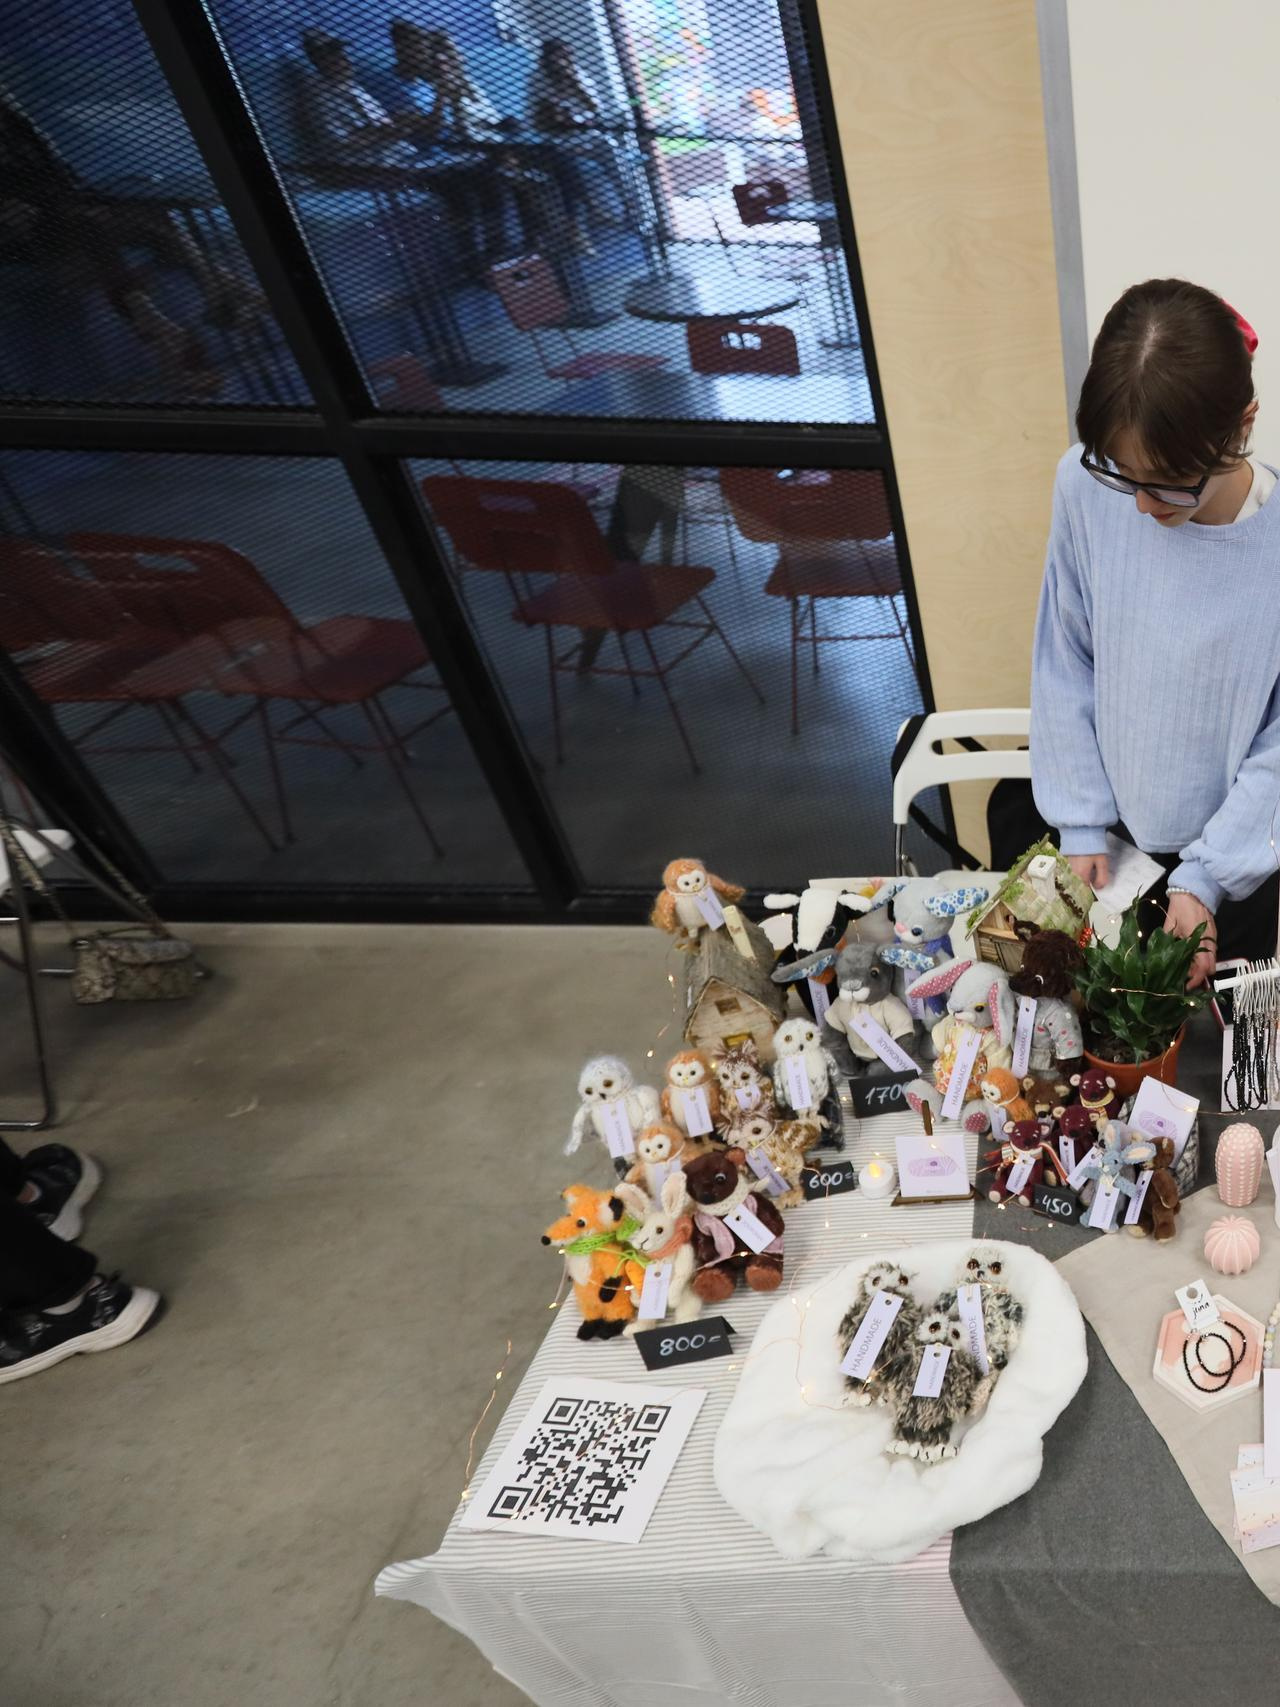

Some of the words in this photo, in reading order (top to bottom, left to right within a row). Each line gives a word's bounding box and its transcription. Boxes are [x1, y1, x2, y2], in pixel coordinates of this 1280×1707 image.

[1042, 1194, 1073, 1217] 450
[851, 1317, 883, 1372] HANDMADE
[969, 1315, 981, 1368] ANDMADE
